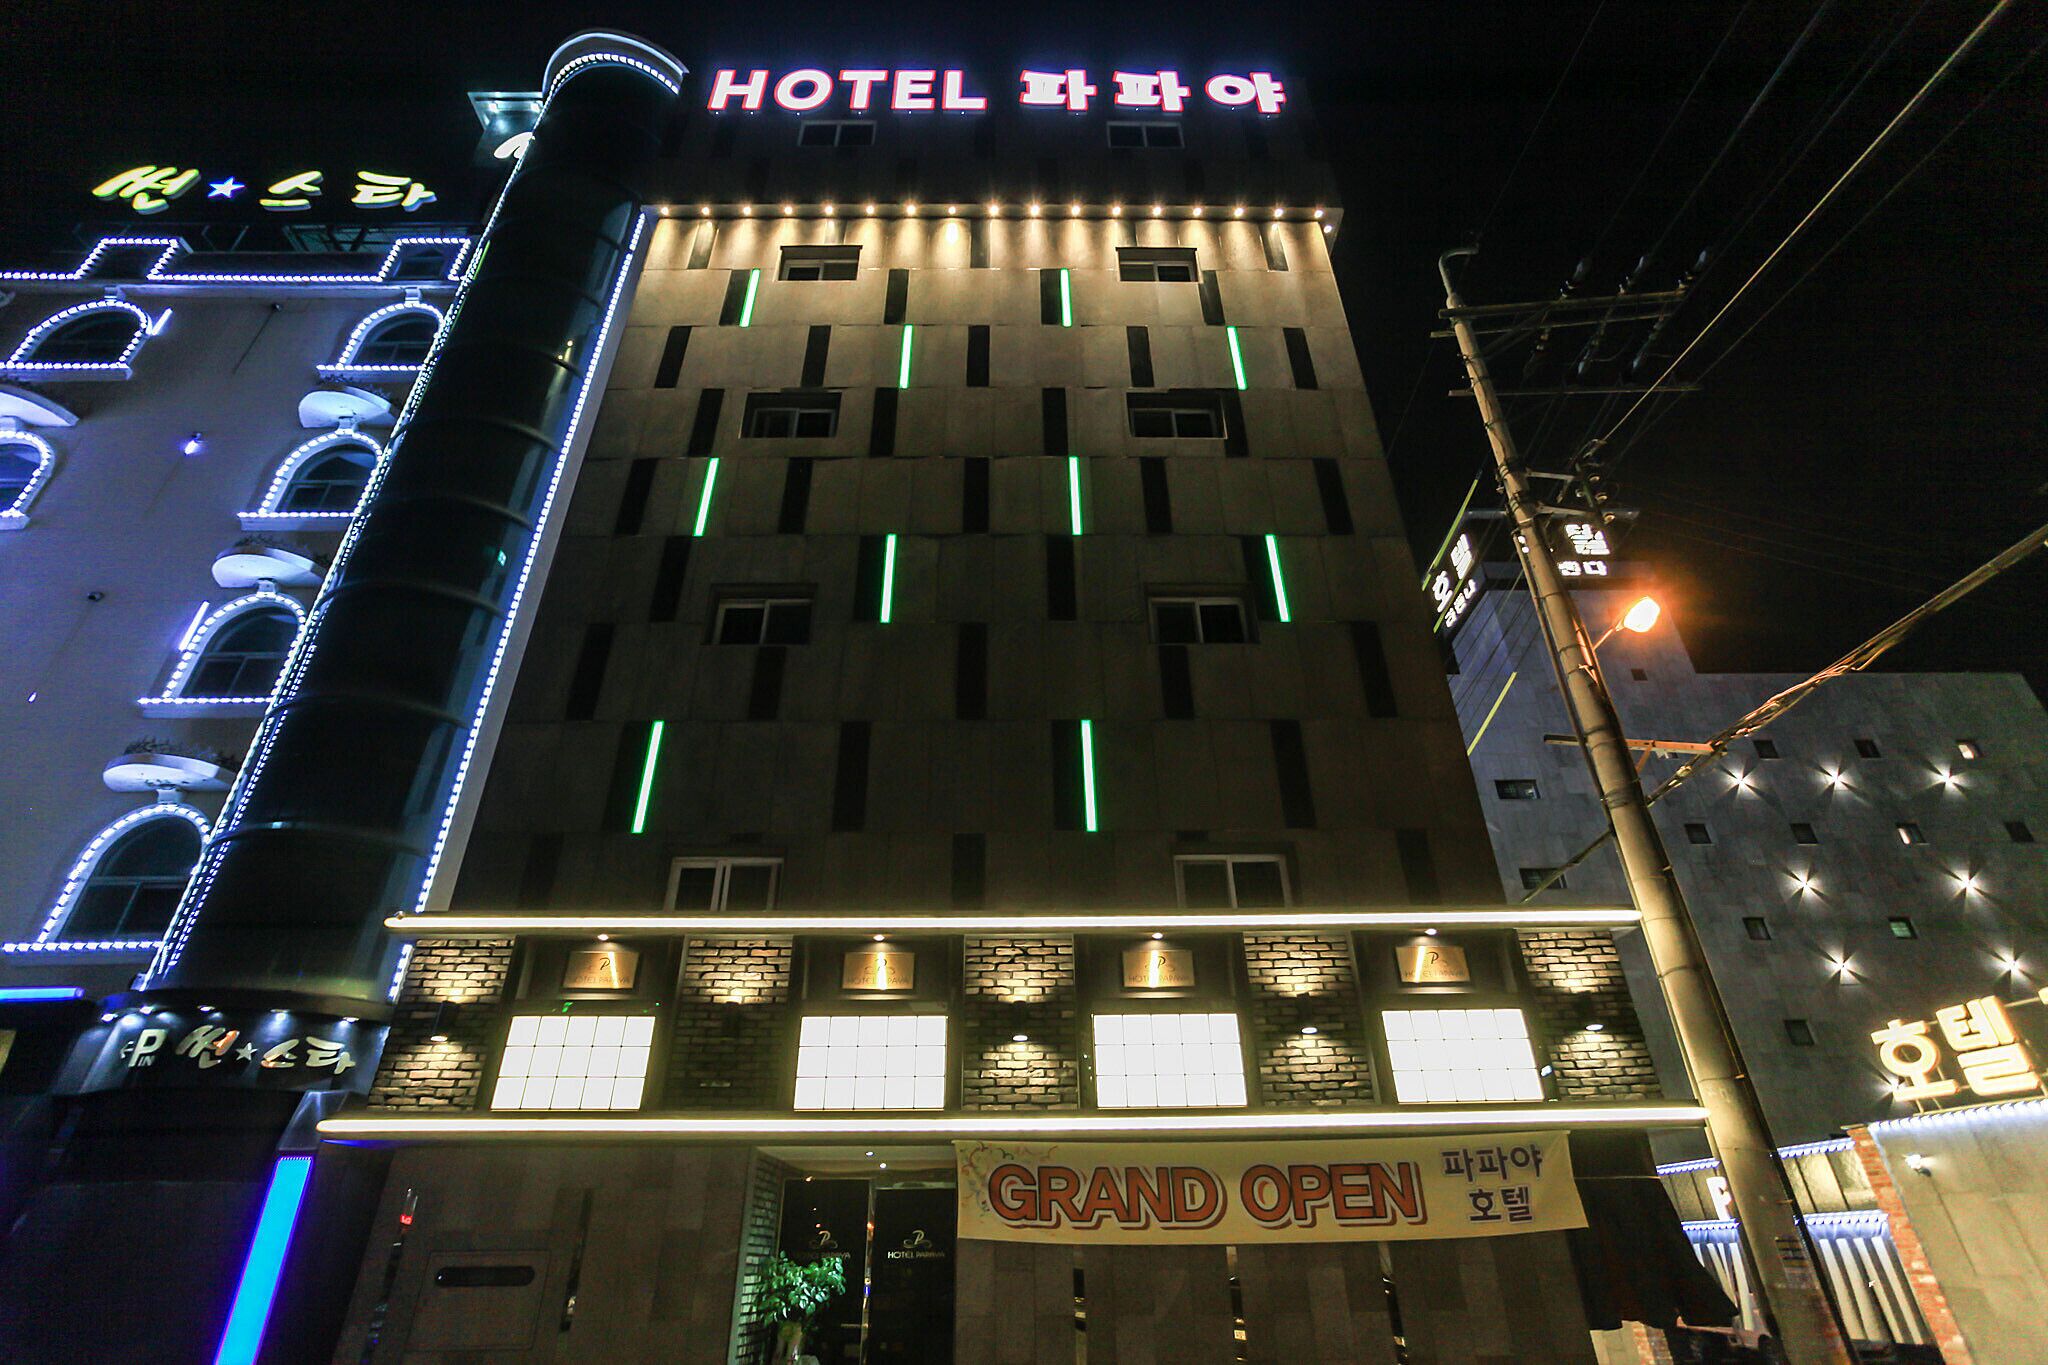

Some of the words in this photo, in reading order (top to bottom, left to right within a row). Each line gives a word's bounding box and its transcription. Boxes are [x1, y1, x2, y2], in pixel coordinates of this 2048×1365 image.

[707, 68, 987, 111] HOTEL
[1020, 68, 1287, 113] 파파야
[1871, 994, 2041, 1102] 호텔
[1442, 1143, 1543, 1182] 파파야
[987, 1162, 1228, 1229] GRAND
[1239, 1160, 1427, 1228] OPEN
[1468, 1188, 1533, 1221] 호텔
[887, 1251, 914, 1259] HOTEL
